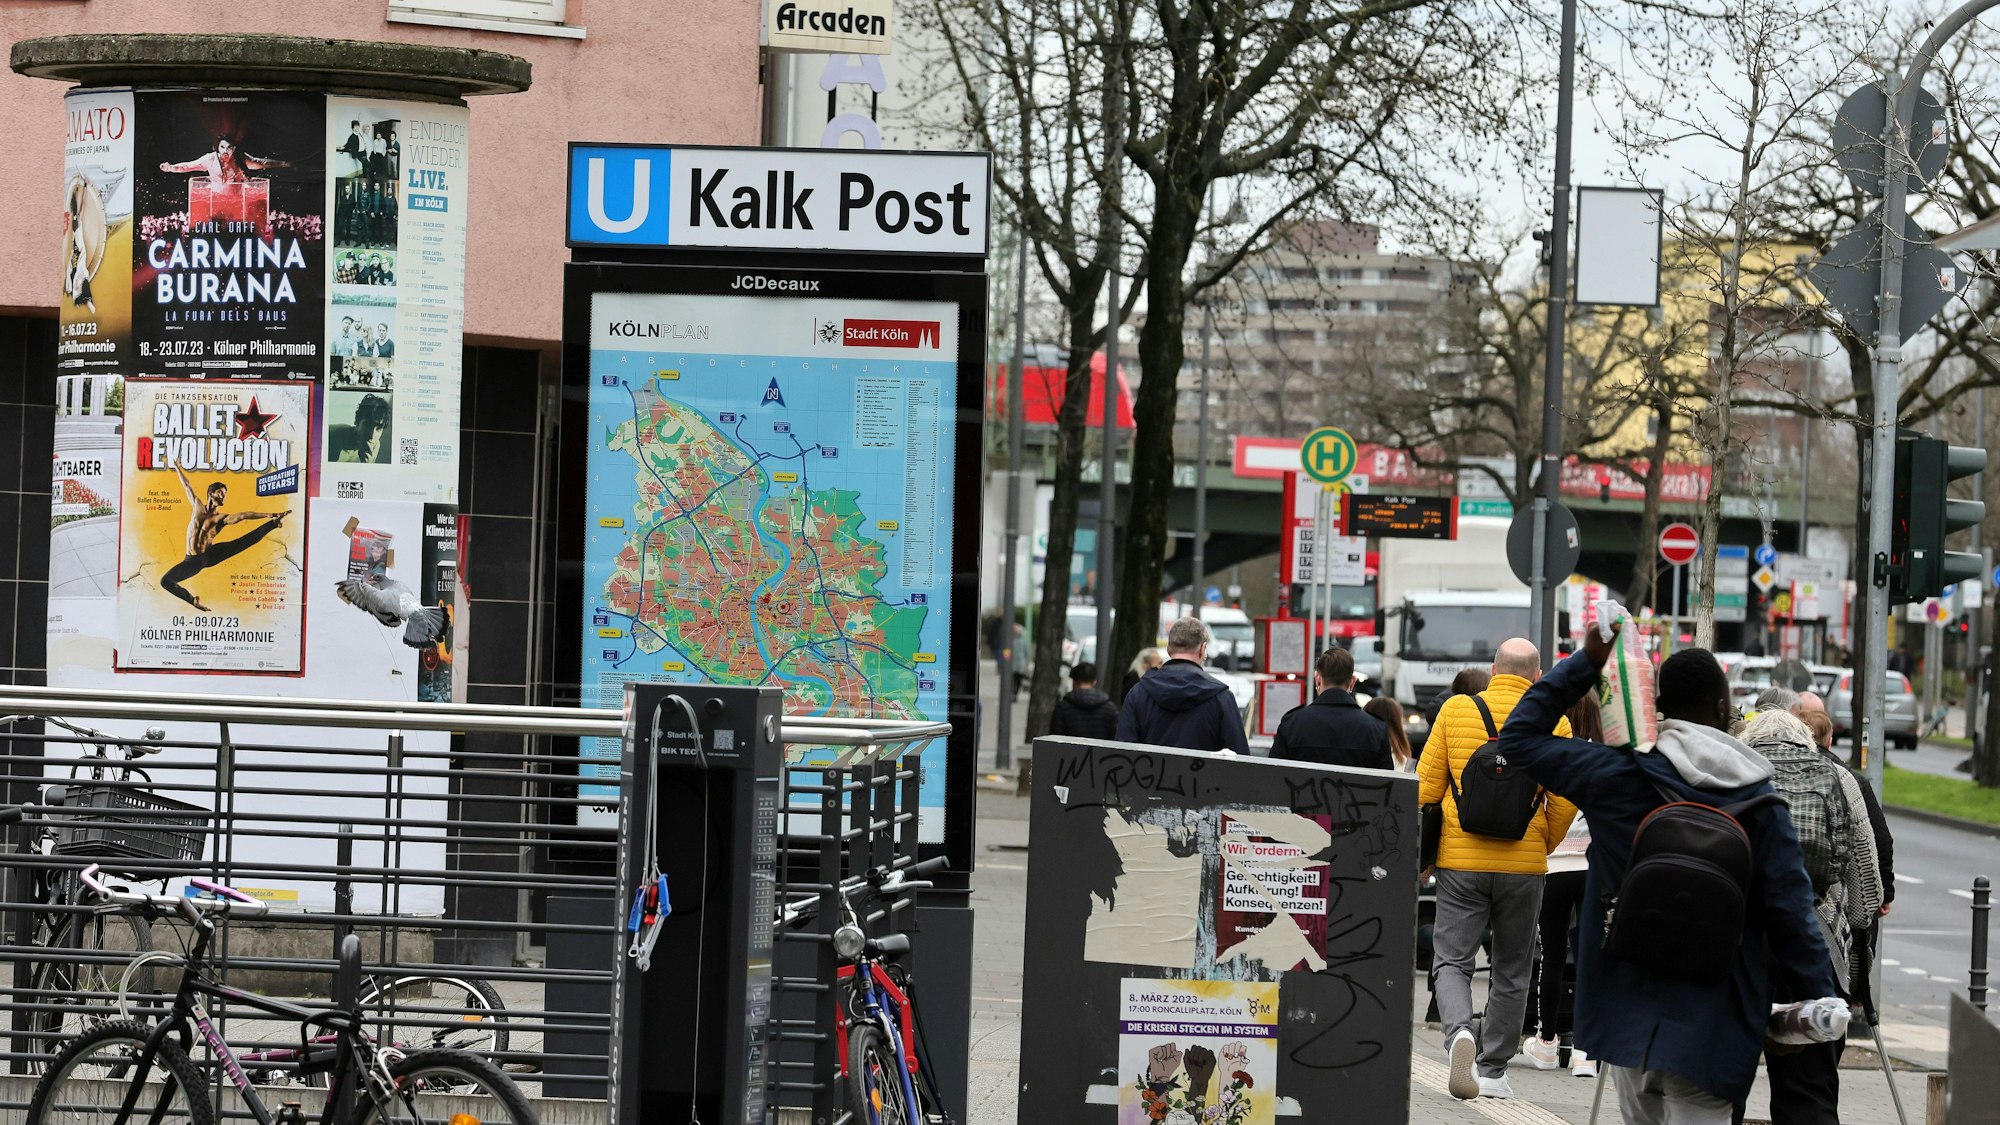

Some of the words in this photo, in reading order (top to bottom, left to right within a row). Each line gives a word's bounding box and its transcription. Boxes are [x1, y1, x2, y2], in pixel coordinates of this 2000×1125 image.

[777, 2, 886, 36] Arcaden
[409, 120, 466, 145] ENDLICH
[86, 146, 93, 154] OF
[93, 145, 110, 155] JAPAN
[409, 145, 462, 169] WIEDER
[408, 168, 449, 191] LIVE.
[415, 197, 423, 207] IN
[425, 197, 444, 209] KÖLN
[587, 157, 652, 234] U
[689, 167, 815, 231] Kalk
[838, 172, 972, 236] Post
[195, 221, 221, 233] CARL
[228, 221, 256, 233] ORFF
[148, 238, 306, 269] CARMINA
[157, 273, 296, 304] BURANA
[731, 274, 820, 292] JCDecaux
[165, 310, 177, 322] LA
[185, 310, 213, 322] FURA
[220, 310, 250, 322] DELS
[258, 310, 287, 322] BAUS
[846, 326, 879, 340] Stadt
[880, 326, 909, 341] Köln
[213, 339, 248, 356] Kölner
[250, 339, 316, 356] Philharmonie
[155, 393, 167, 401] DIE
[171, 393, 239, 402] TANZSENSATION
[767, 388, 779, 399] N
[153, 403, 240, 437] BALLET
[137, 431, 290, 472] REVOLUCIÓN
[1315, 441, 1342, 472] H
[258, 468, 296, 485] CELEBRATING
[258, 483, 268, 493] 10
[268, 476, 295, 491] YEARS!
[337, 481, 350, 491] FKP
[337, 490, 364, 500] SCORPIO
[437, 513, 447, 525] Wer
[426, 524, 445, 537] Klima
[140, 626, 182, 641] KÖLNER
[185, 629, 275, 643] PHILHARMONIE
[667, 730, 687, 740] Stadt
[661, 746, 678, 755] BIK
[1228, 843, 1248, 856] Wir
[1226, 897, 1323, 911] Konseqenzen!
[1129, 993, 1138, 1002] 8.
[1140, 992, 1169, 1003] MÄRZ
[1172, 995, 1198, 1004] 2023
[1129, 1005, 1151, 1013] 17:00
[1152, 1005, 1218, 1016] RONCALLIPLATZ,
[1219, 1007, 1242, 1016] KÖLN
[1128, 1022, 1143, 1032] DIE
[1144, 1023, 1179, 1033] KRISEN
[1179, 1024, 1220, 1034] STECKEN
[1221, 1025, 1233, 1034] IM
[1233, 1025, 1269, 1036] SYSTEM
